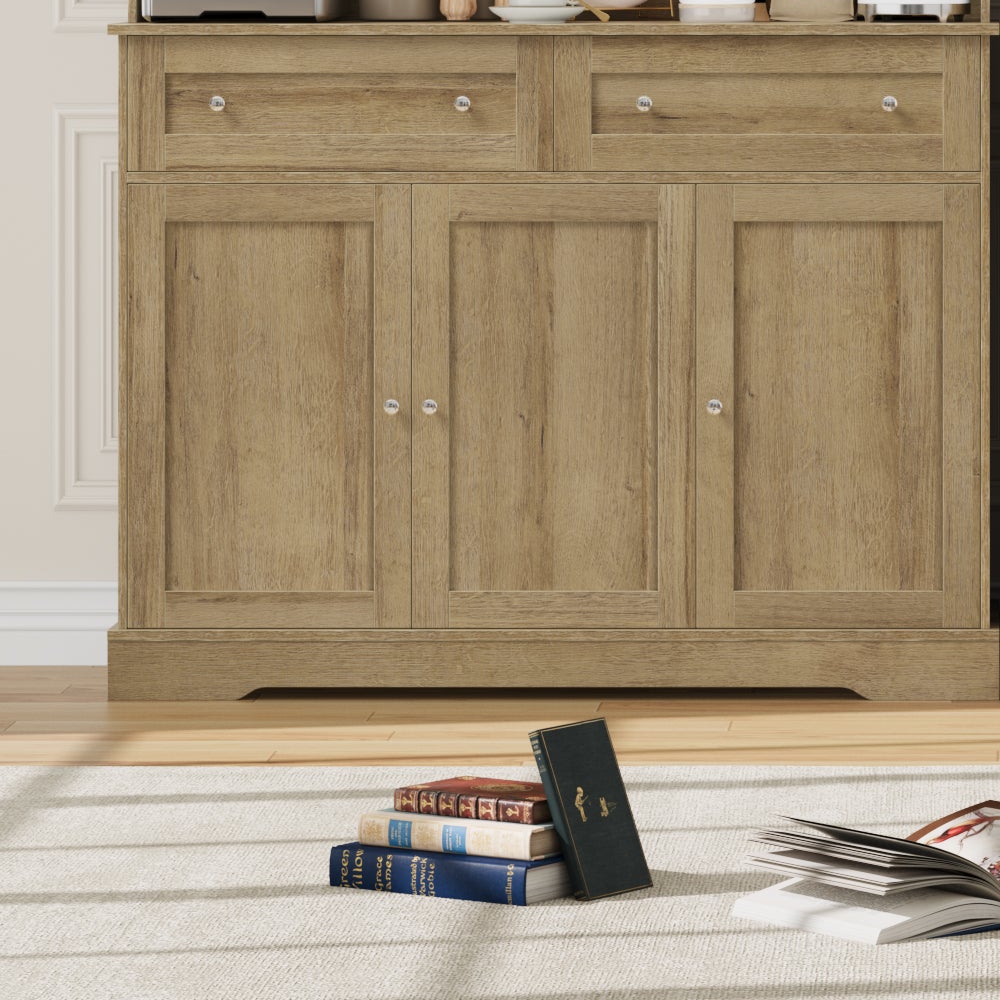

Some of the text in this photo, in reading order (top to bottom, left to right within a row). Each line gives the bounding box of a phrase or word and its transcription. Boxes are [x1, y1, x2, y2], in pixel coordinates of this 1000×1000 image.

[352, 849, 365, 890] illow
[374, 855, 384, 891] Grace
[385, 854, 393, 891] ames
[410, 862, 418, 896] ustrated
